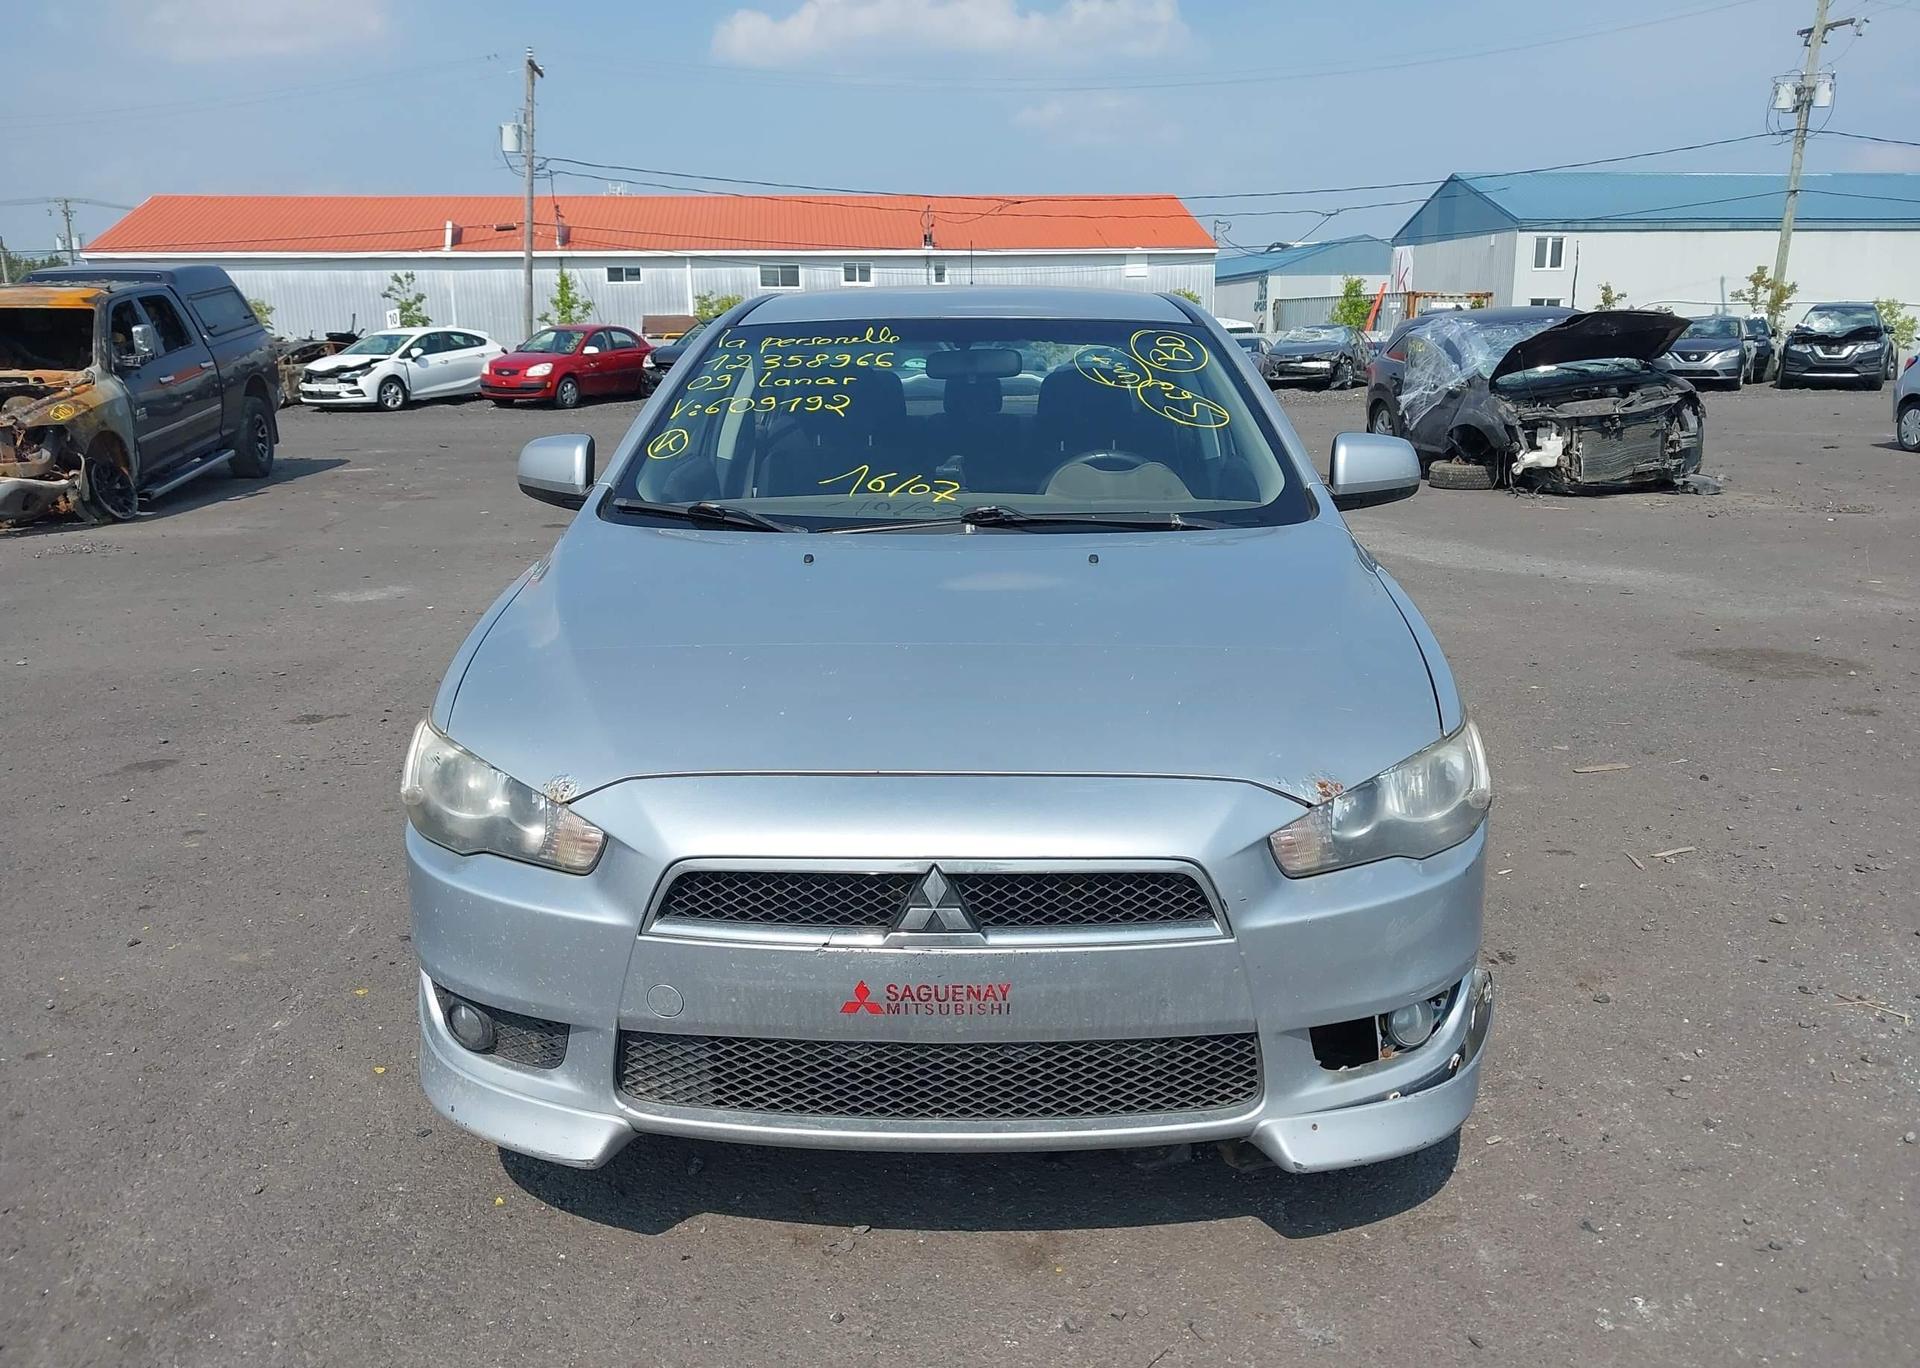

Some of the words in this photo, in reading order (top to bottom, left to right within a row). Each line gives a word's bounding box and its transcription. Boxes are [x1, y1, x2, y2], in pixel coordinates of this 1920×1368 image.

[389, 312, 397, 325] 10
[885, 983, 1011, 1002] SAGUENAY
[886, 1002, 1011, 1015] MITSUBISHI
